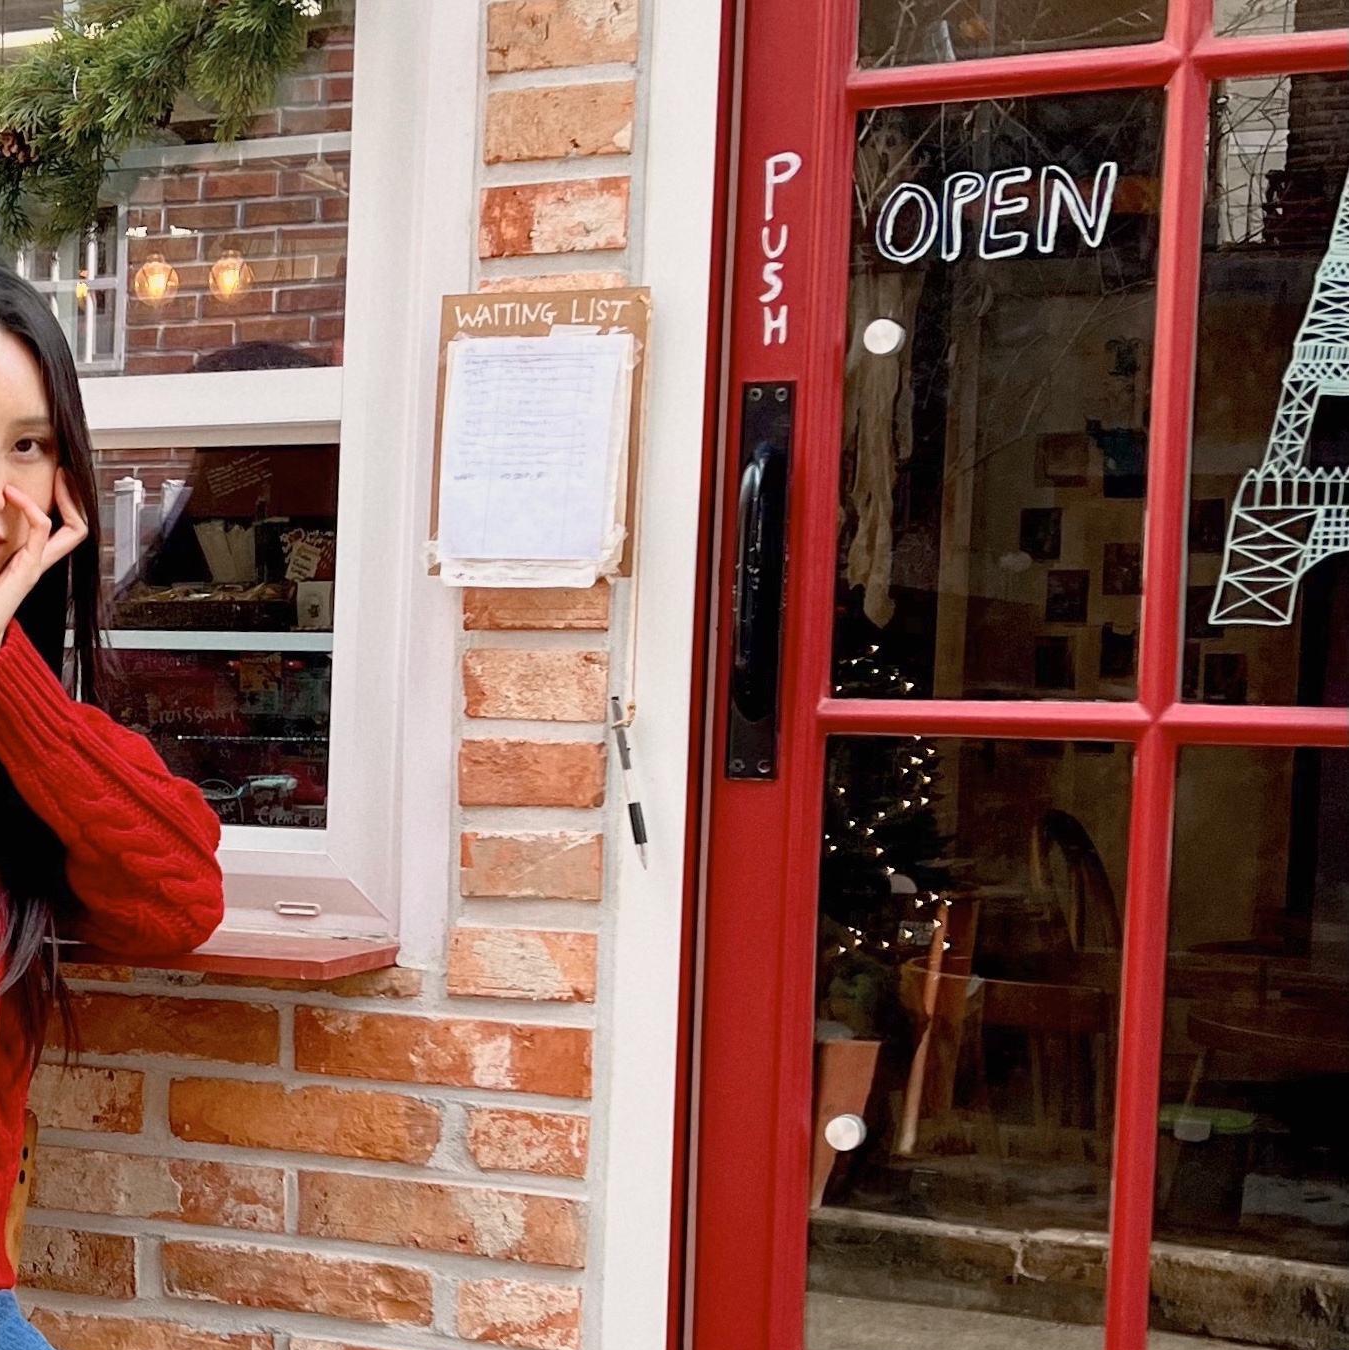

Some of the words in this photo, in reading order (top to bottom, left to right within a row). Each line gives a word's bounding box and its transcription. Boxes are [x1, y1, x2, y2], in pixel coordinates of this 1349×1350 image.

[759, 151, 802, 346] PUSH
[875, 161, 1118, 264] OPEN
[454, 301, 558, 328] WAITING
[570, 297, 632, 324] LIST
